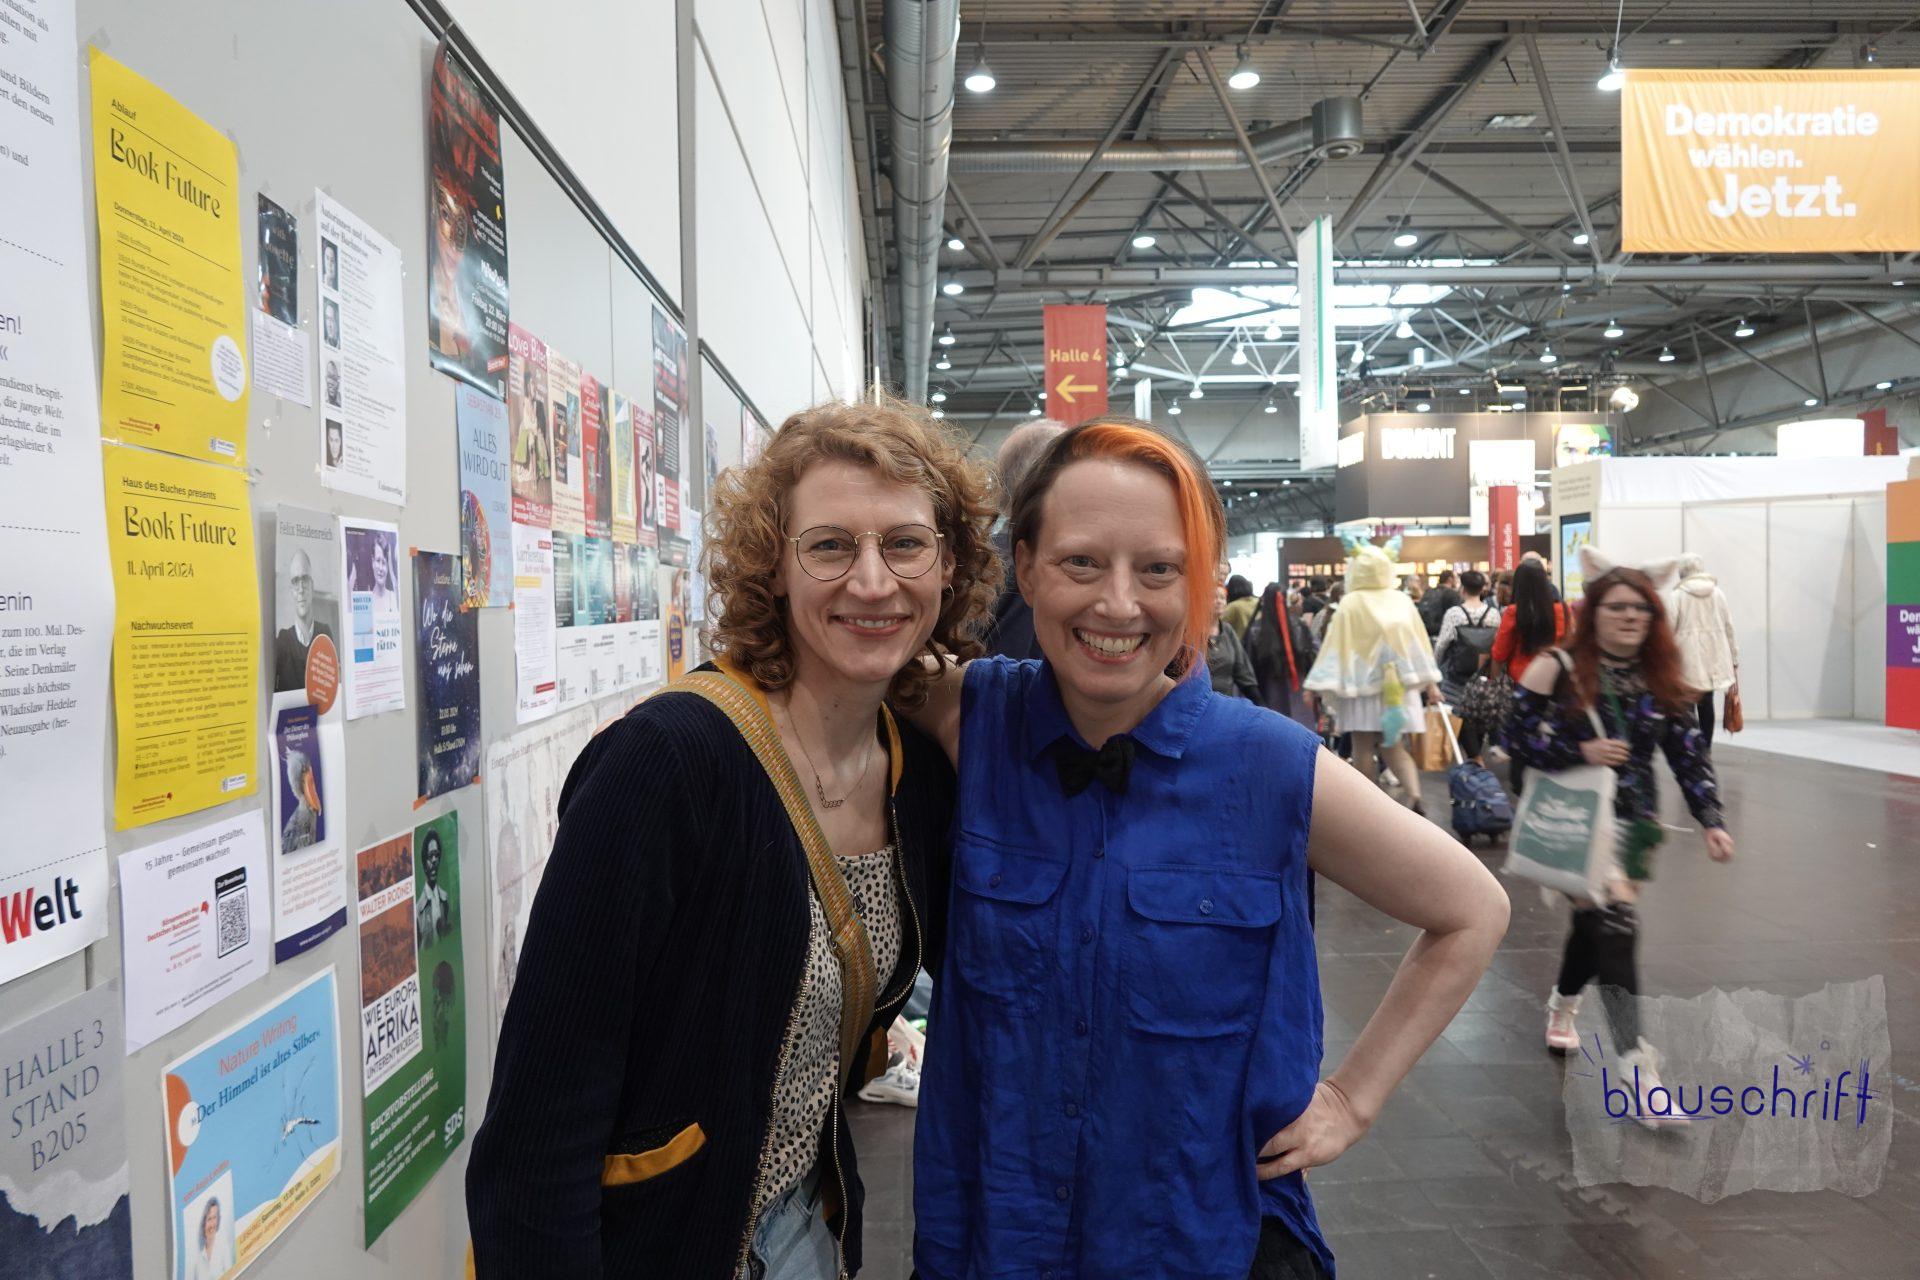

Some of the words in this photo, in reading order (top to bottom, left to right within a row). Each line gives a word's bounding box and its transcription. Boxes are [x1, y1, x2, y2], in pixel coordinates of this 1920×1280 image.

[19, 77, 50, 105] Bildern
[11, 93, 28, 110] den
[30, 106, 55, 126] neuen
[111, 99, 137, 120] Ablauf
[1664, 104, 1879, 136] Demokratie
[12, 149, 30, 167] und
[1689, 143, 1802, 168] wählen.
[111, 128, 159, 185] Book
[166, 161, 221, 219] Future
[1708, 174, 1857, 218] Jetzt.
[508, 333, 529, 357] Love
[531, 339, 547, 370] Bites
[1050, 349, 1090, 363] Halle
[1093, 349, 1103, 362] 4
[4, 395, 18, 409] die
[19, 400, 43, 416] junge
[45, 404, 65, 420] Welt.
[35, 422, 49, 434] die
[50, 425, 62, 437] im
[473, 428, 497, 454] ALLES
[1381, 428, 1456, 460] DUMONT
[464, 453, 488, 477] WIRD
[490, 462, 508, 483] GUT
[122, 476, 143, 489] Haus
[144, 480, 158, 492] des
[160, 483, 187, 496] Buches
[188, 488, 216, 500] presents
[124, 505, 175, 541] Book
[180, 513, 237, 546] Future
[296, 524, 333, 541] Heidenreich
[127, 560, 137, 576] 11.
[140, 560, 165, 580] April
[167, 561, 194, 578] 2024
[2, 628, 23, 639] zum
[45, 624, 64, 636] Mal.
[67, 624, 86, 636] Des-
[131, 620, 194, 631] Nachwuchsevent
[9, 645, 23, 657] die
[26, 645, 38, 656] im
[40, 643, 67, 659] Verlag
[430, 627, 457, 660] Sterne
[5, 664, 30, 678] Seine
[32, 661, 77, 675] Denkmäler
[23, 683, 35, 694] als
[37, 680, 71, 693] höchstes
[1, 702, 45, 717] Wladislaw
[47, 698, 78, 711] Hedeler
[0, 720, 51, 737] Neuausgabe
[154, 853, 173, 868] Jahre
[183, 838, 217, 857] Gemeinsam
[168, 859, 204, 880] gemeinsam
[0, 876, 83, 945] Welt
[360, 894, 386, 916] WALTER
[386, 882, 413, 905] RODNEY
[363, 1004, 382, 1028] WIE
[385, 979, 417, 1016] EUROPA
[219, 1038, 260, 1078] Nature
[262, 1015, 298, 1048] Writing
[366, 1007, 419, 1065] AFRIKA
[4, 1028, 84, 1098] HALLE
[92, 1019, 104, 1049] 3
[367, 1028, 420, 1079] UNTERENTWICKELTE
[191, 1099, 216, 1126] »Der
[219, 1072, 258, 1108] Himmel
[260, 1062, 271, 1077] ist
[272, 1048, 291, 1072] altes
[292, 1030, 320, 1057] Silber«
[11, 1065, 100, 1140] STAND
[370, 1068, 434, 1135] BUCHVORSTELLUNG
[444, 1106, 464, 1142] SDS
[31, 1112, 87, 1173] B205
